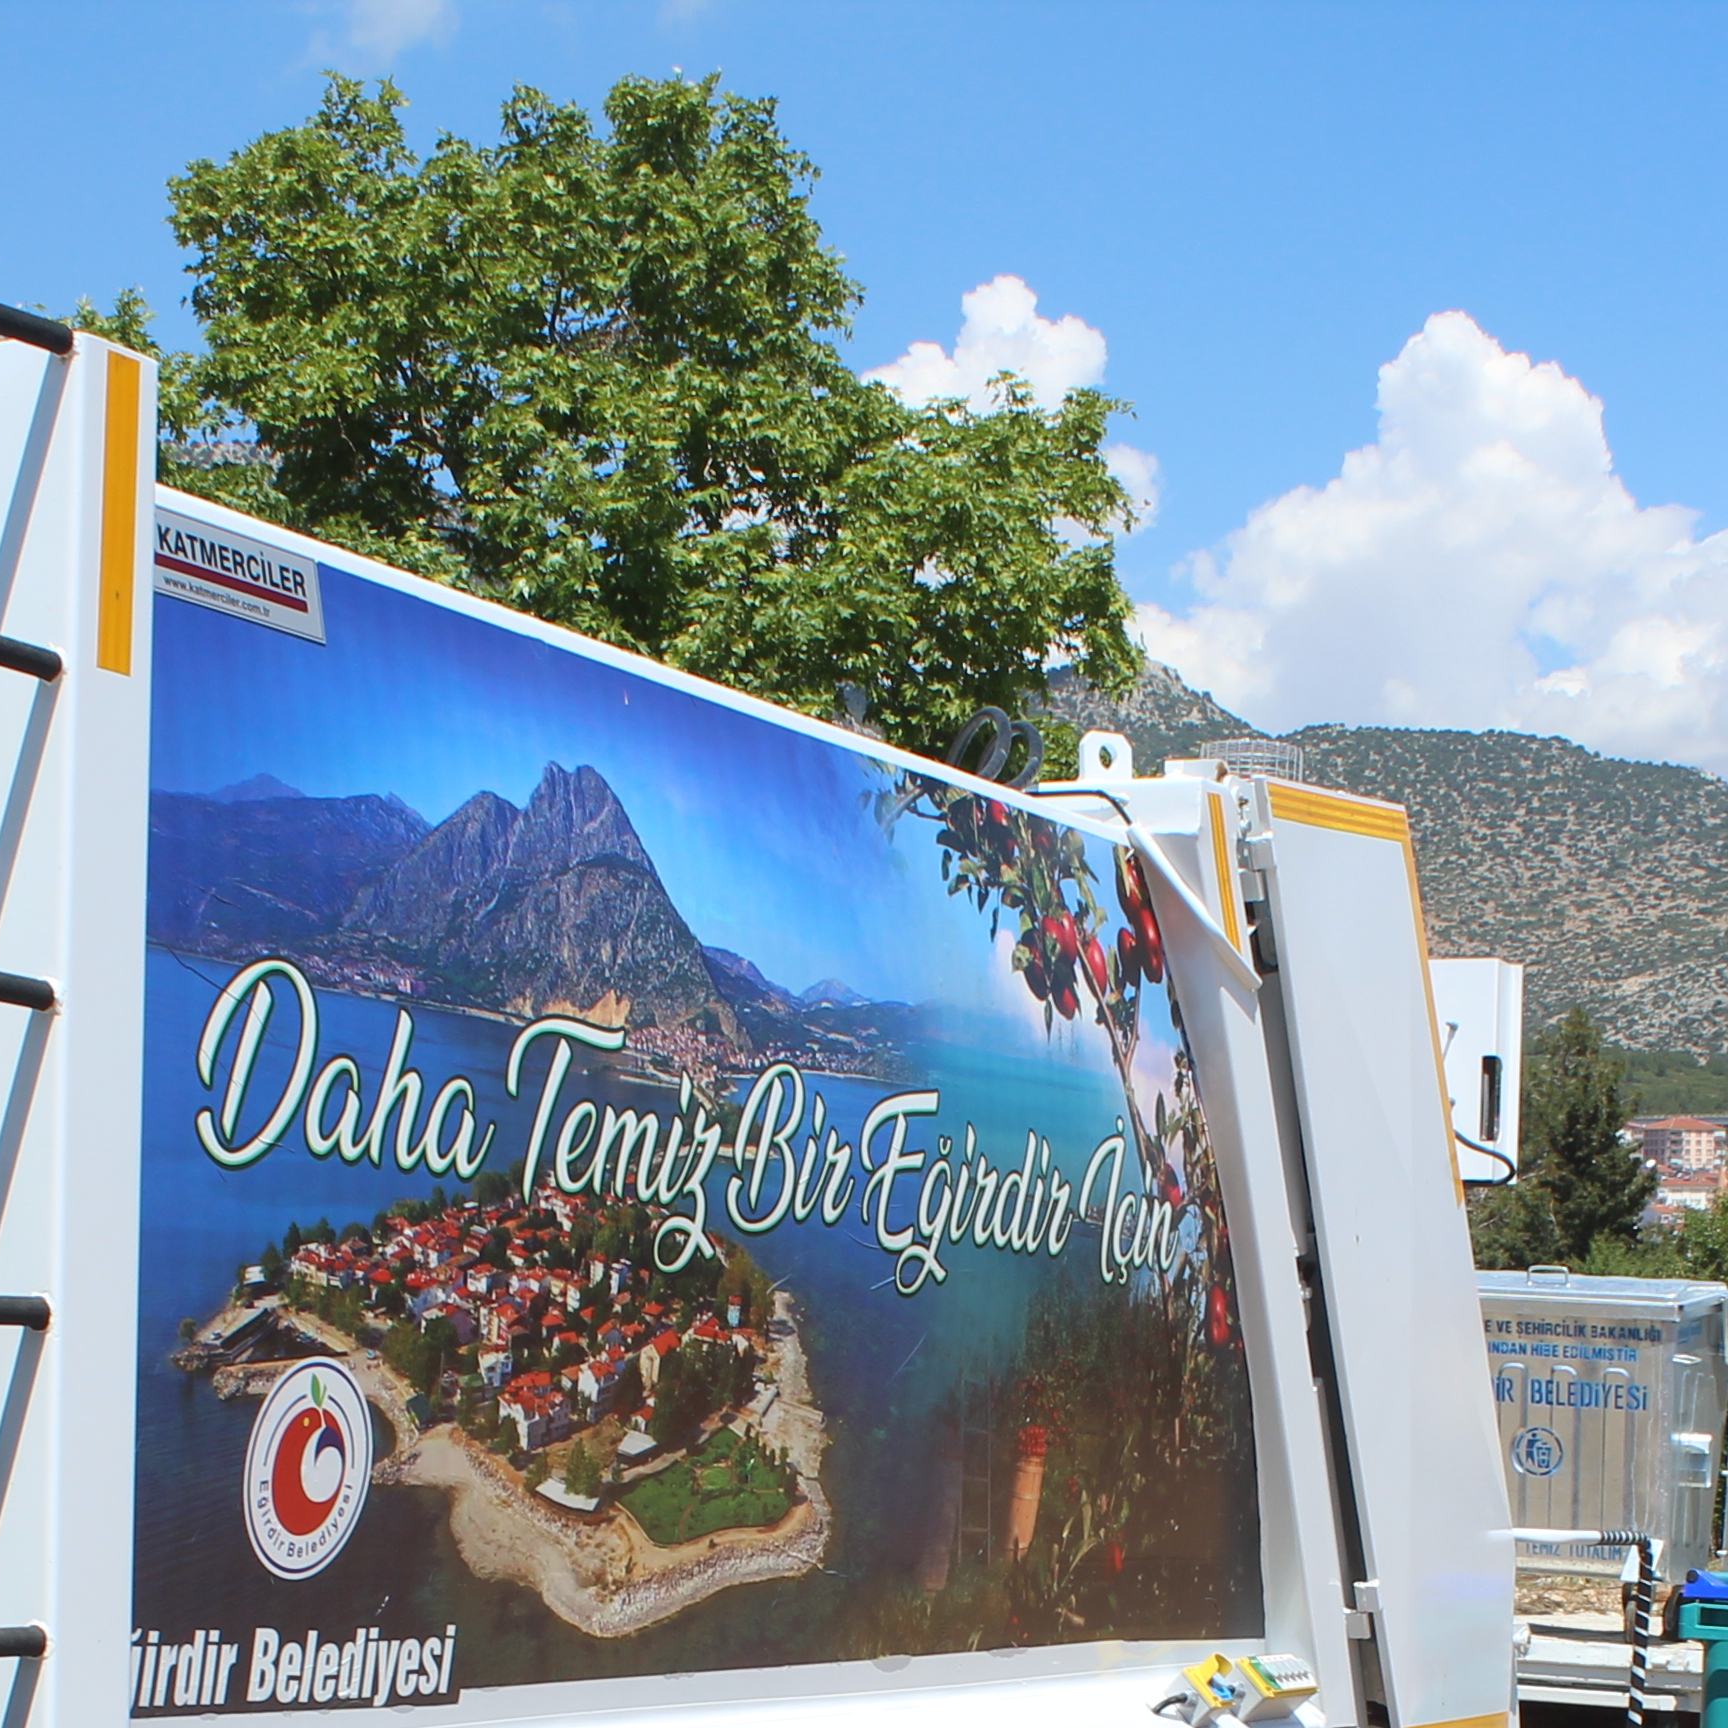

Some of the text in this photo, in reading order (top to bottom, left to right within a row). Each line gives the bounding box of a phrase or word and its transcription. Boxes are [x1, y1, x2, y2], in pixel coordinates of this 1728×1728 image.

[157, 523, 307, 598] KATMERCİLER
[163, 575, 271, 617] www.katmerciler.com.tr
[197, 958, 1178, 1296] Daha Temiz Bir Eğirdir İçin
[1530, 1378, 1648, 1411] BELEDİYESİ
[286, 1483, 354, 1558] Belediyesi
[246, 1624, 457, 1707] Belediyesi
